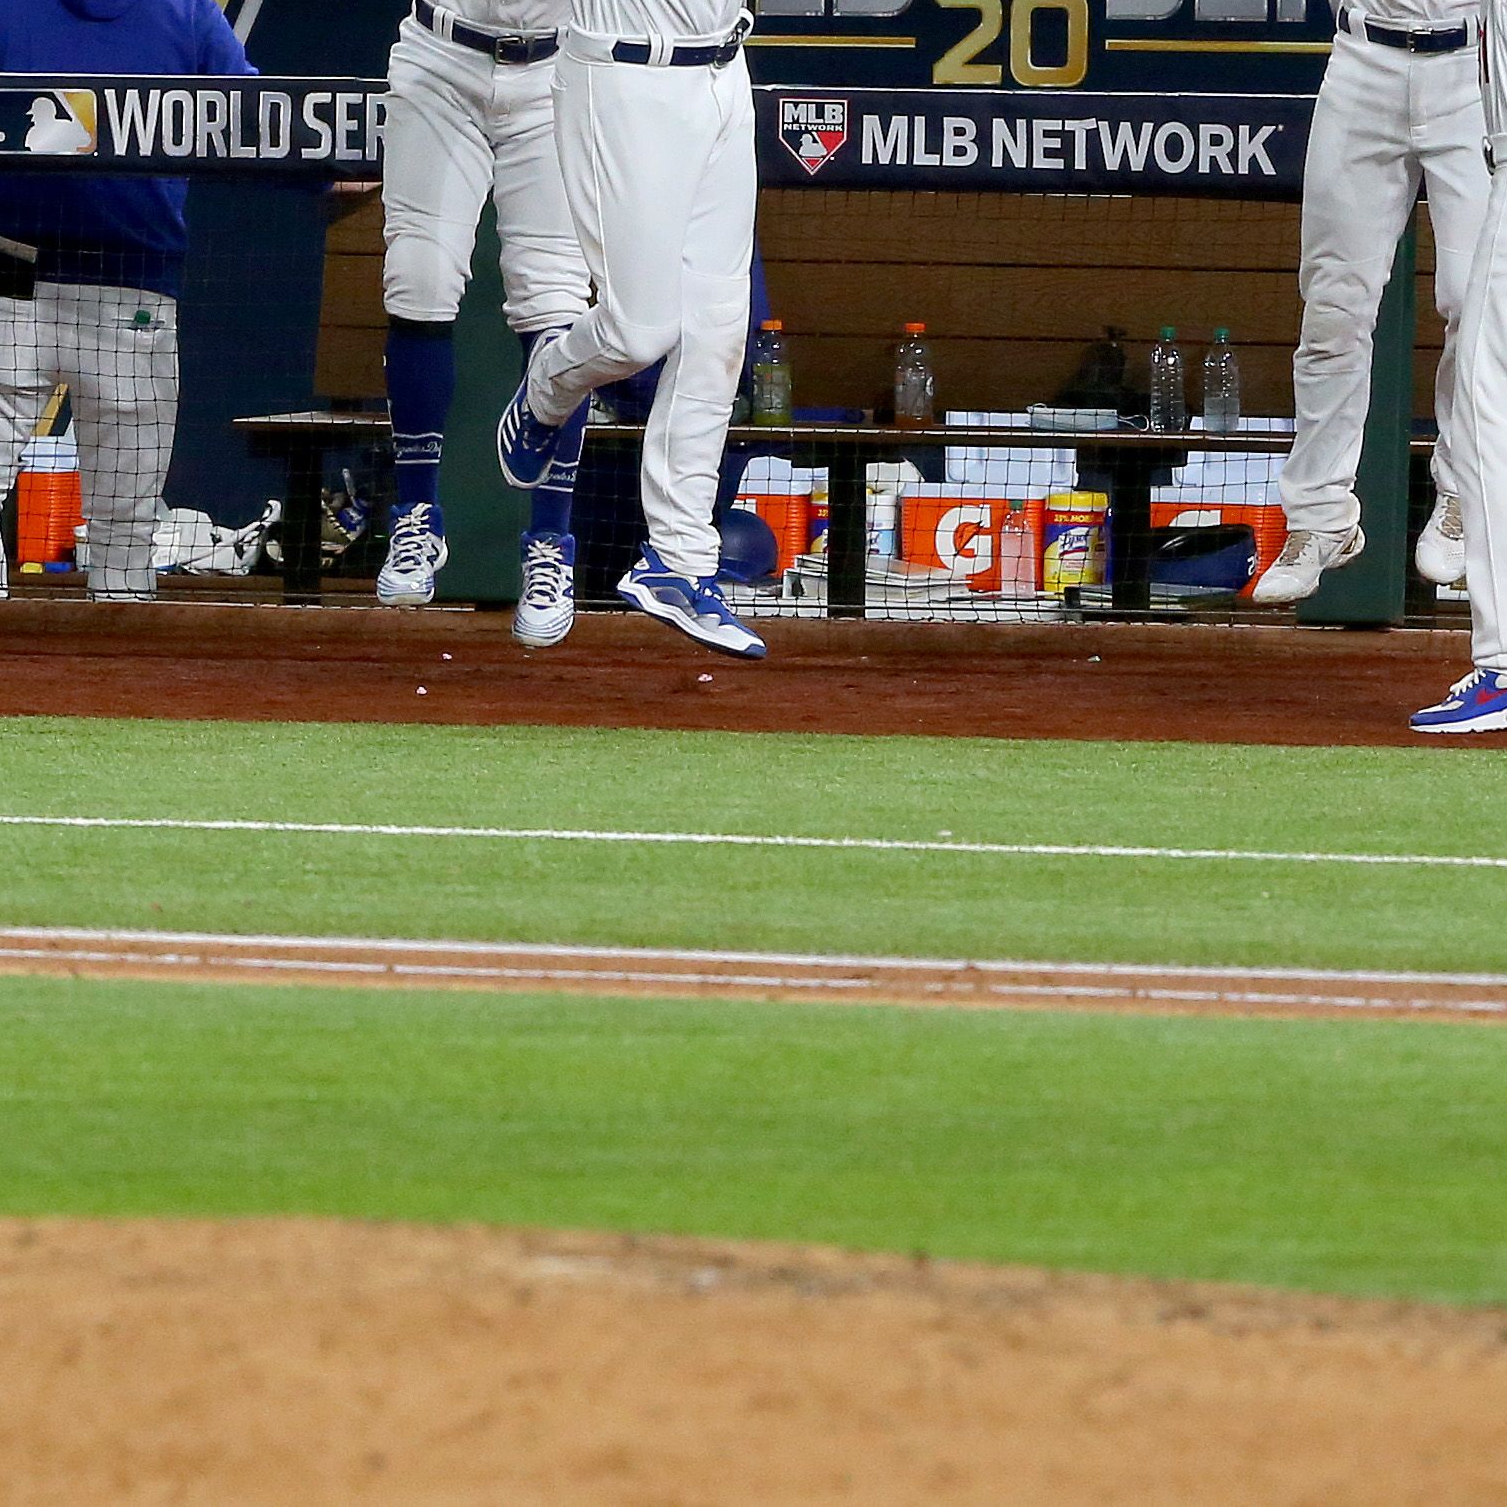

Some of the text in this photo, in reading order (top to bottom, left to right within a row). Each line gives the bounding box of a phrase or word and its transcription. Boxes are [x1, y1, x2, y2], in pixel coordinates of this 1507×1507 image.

[103, 88, 293, 160] WORLD
[783, 103, 844, 124] MLB
[783, 123, 844, 132] NETWORK
[861, 114, 1279, 176] MLB NETWORK
